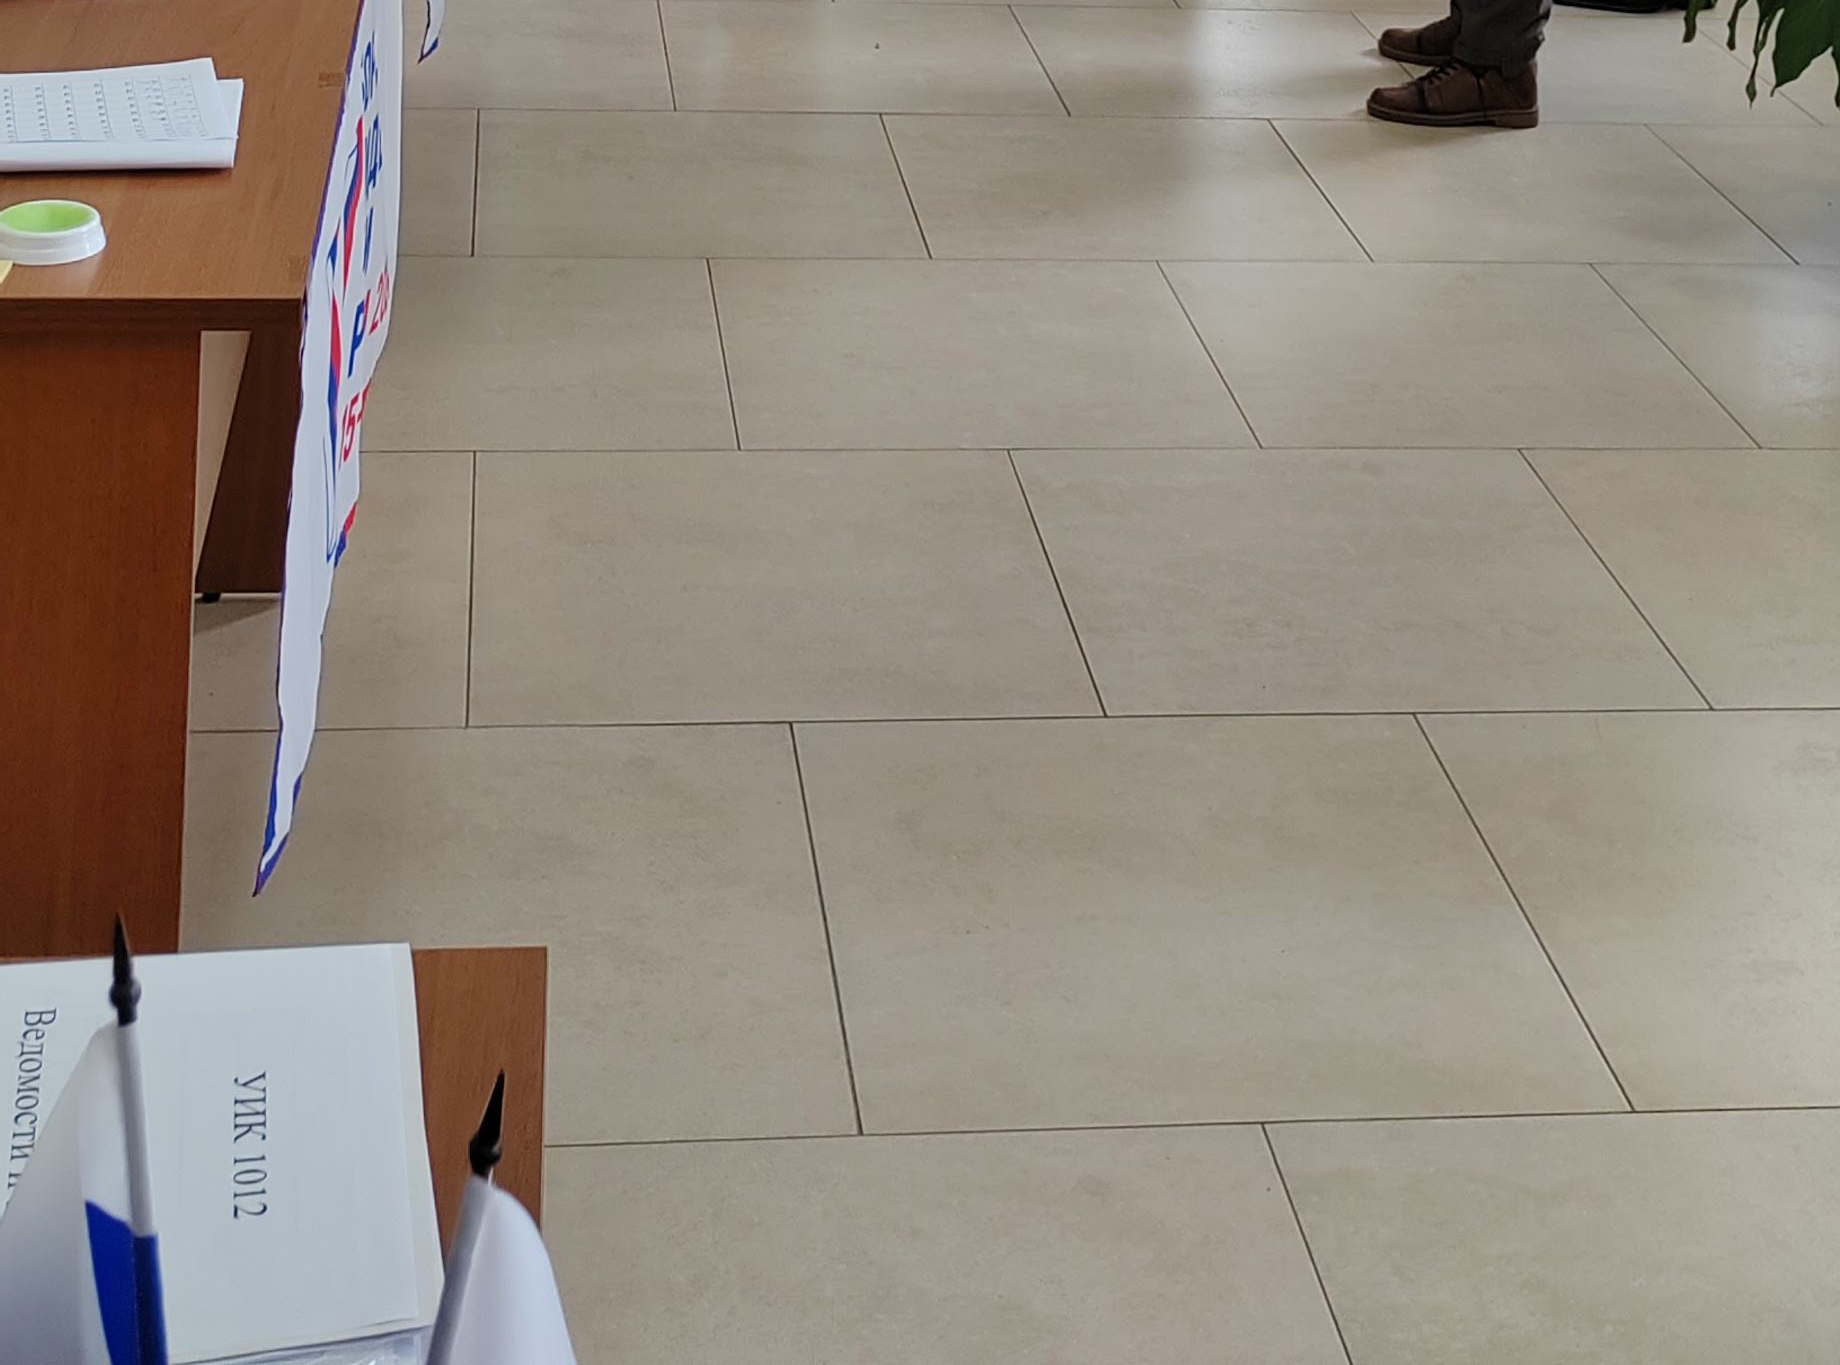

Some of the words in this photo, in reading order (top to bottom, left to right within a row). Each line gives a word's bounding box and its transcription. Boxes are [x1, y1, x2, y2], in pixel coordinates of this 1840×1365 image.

[9, 1007, 57, 1161] Ведомости
[233, 1070, 267, 1144] УИК
[232, 1154, 268, 1220] 1012
